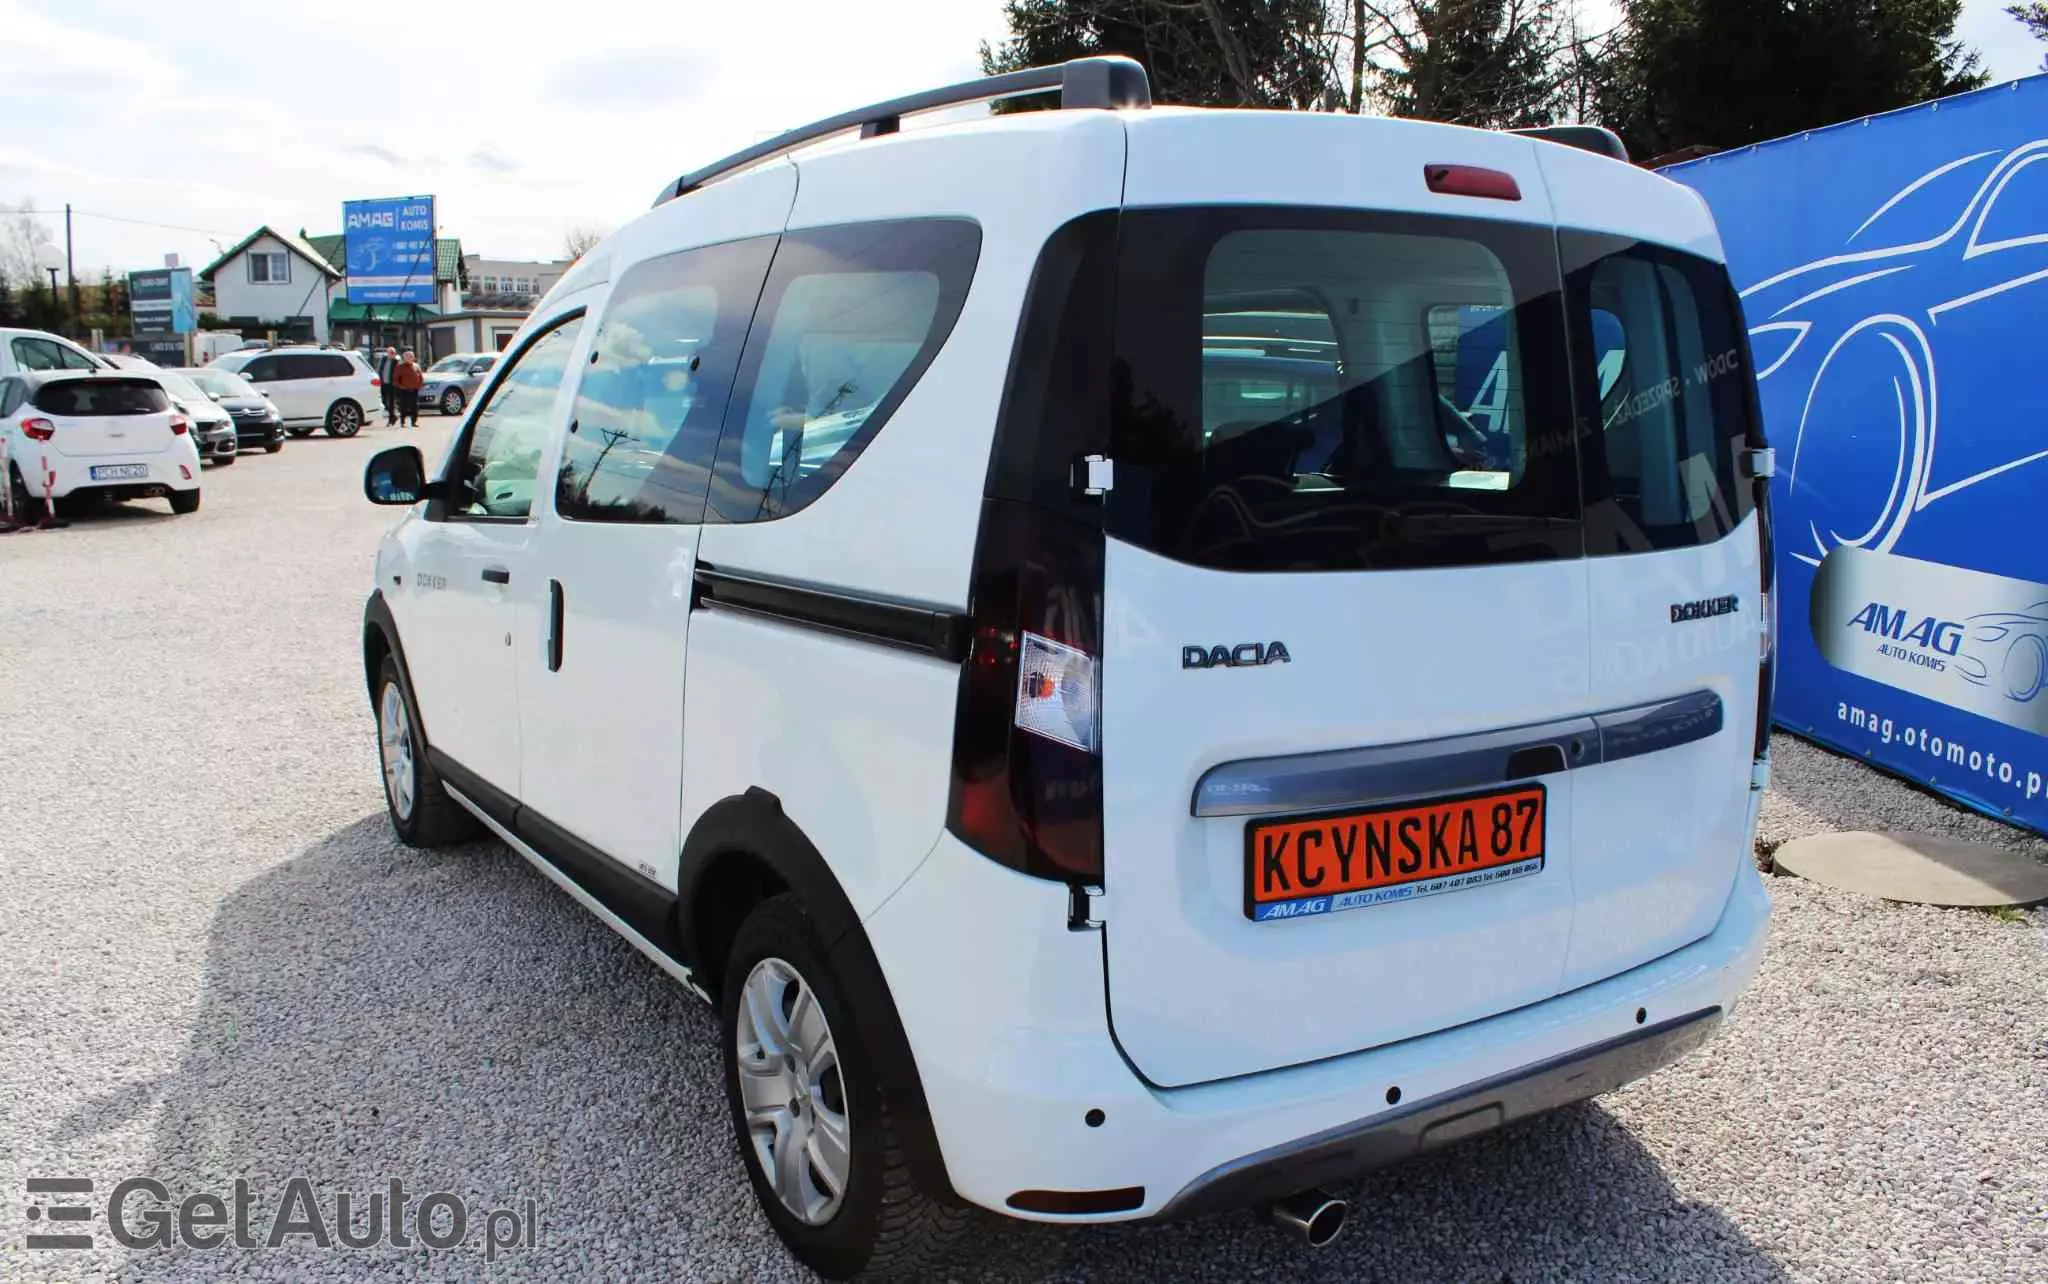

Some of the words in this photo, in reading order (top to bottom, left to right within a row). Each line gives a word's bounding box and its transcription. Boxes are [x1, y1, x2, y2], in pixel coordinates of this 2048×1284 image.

[348, 212, 394, 228] AMAG
[402, 205, 427, 216] AUTO
[401, 219, 429, 231] KOMIS
[1670, 594, 1739, 623] DOKKER
[1847, 602, 1965, 656] AMAG
[1183, 641, 1292, 669] DACIA
[1876, 643, 1907, 661] AUTO
[1907, 651, 1946, 673] KOMIS
[1837, 702, 2048, 798] amag.otomoto.p
[1263, 808, 1479, 893] KCYNSKA
[1491, 798, 1539, 857] 87
[1264, 898, 1328, 920] AMAG
[1340, 891, 1373, 907] AUTO
[1374, 884, 1414, 904] KOMIS
